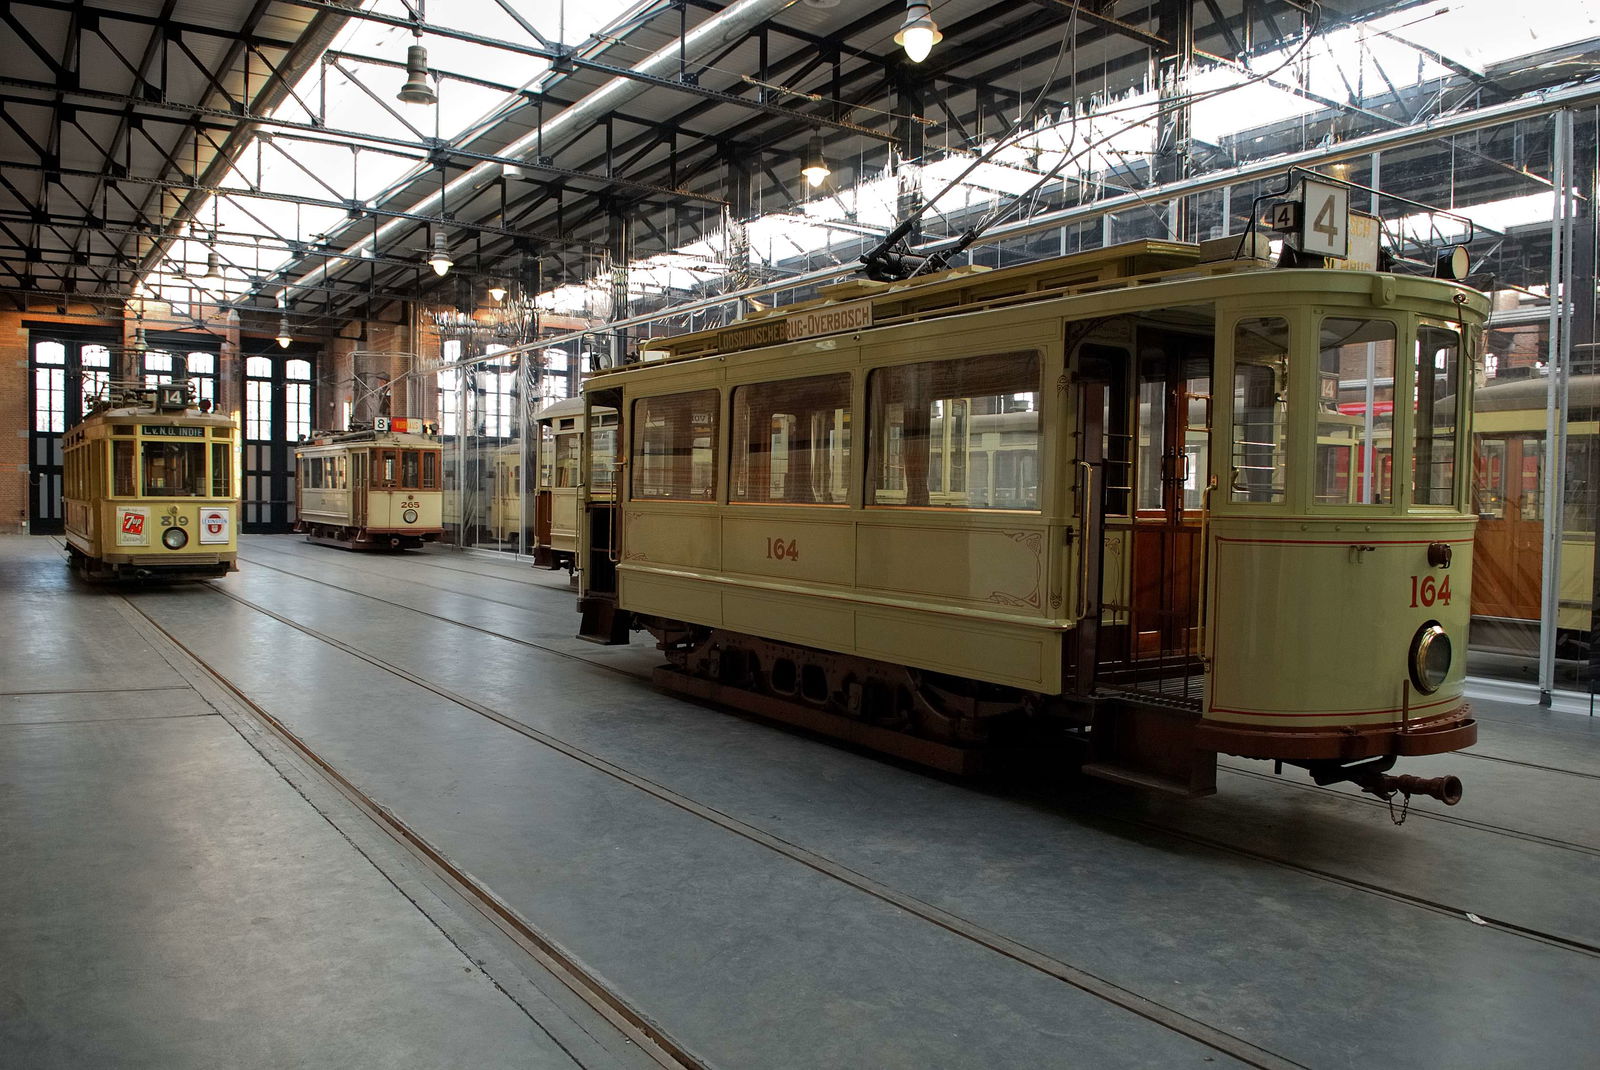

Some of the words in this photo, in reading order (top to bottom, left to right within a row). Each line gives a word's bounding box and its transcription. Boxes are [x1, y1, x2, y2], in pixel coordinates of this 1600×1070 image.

[1277, 207, 1290, 226] 4
[1312, 194, 1339, 247] 4
[1320, 379, 1334, 398] 14
[163, 390, 182, 404] 14
[377, 418, 386, 429] 8
[179, 428, 203, 437] INDIE
[401, 501, 420, 509] 265
[161, 515, 189, 526] 819
[766, 537, 799, 561] 164
[1409, 574, 1452, 609] 164
